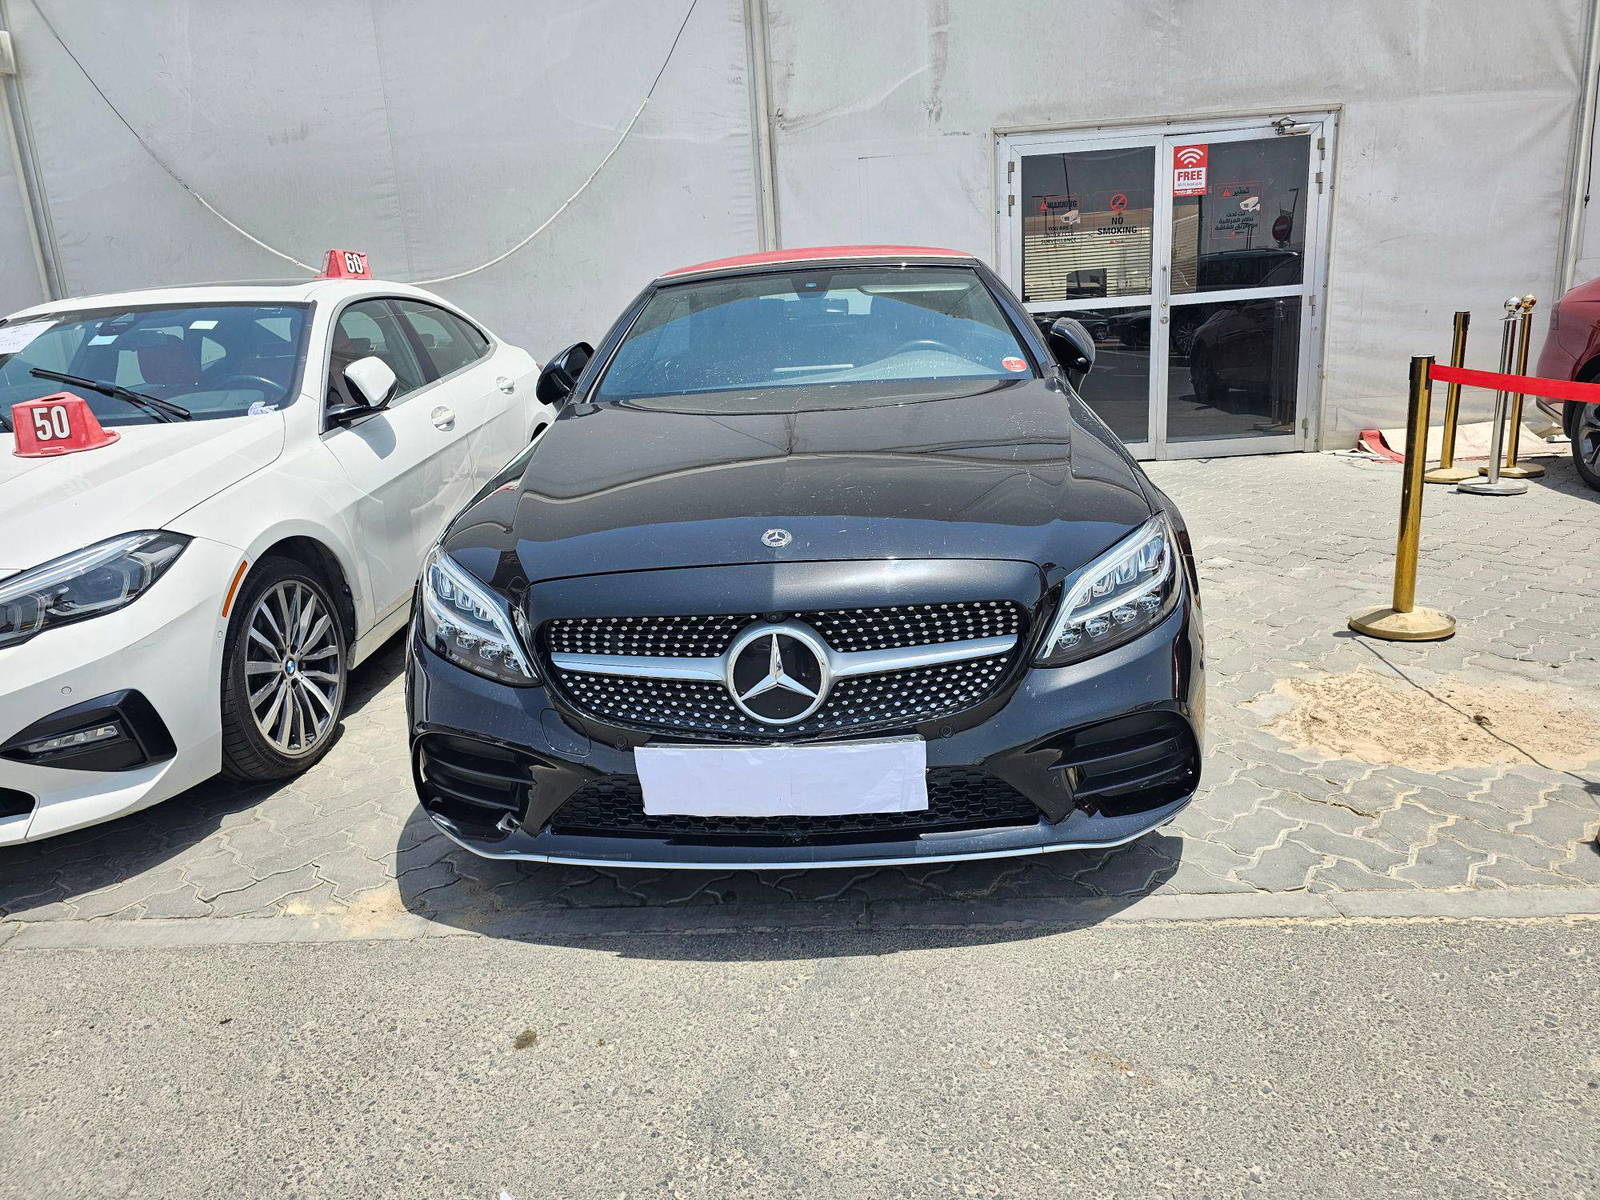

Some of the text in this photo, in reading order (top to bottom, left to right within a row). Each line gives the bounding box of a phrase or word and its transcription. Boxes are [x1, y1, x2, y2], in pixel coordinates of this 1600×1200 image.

[1177, 170, 1203, 181] FREE
[1112, 217, 1124, 225] NO
[1097, 226, 1138, 236] SMOKING
[344, 252, 365, 274] 60
[32, 406, 71, 441] 50
